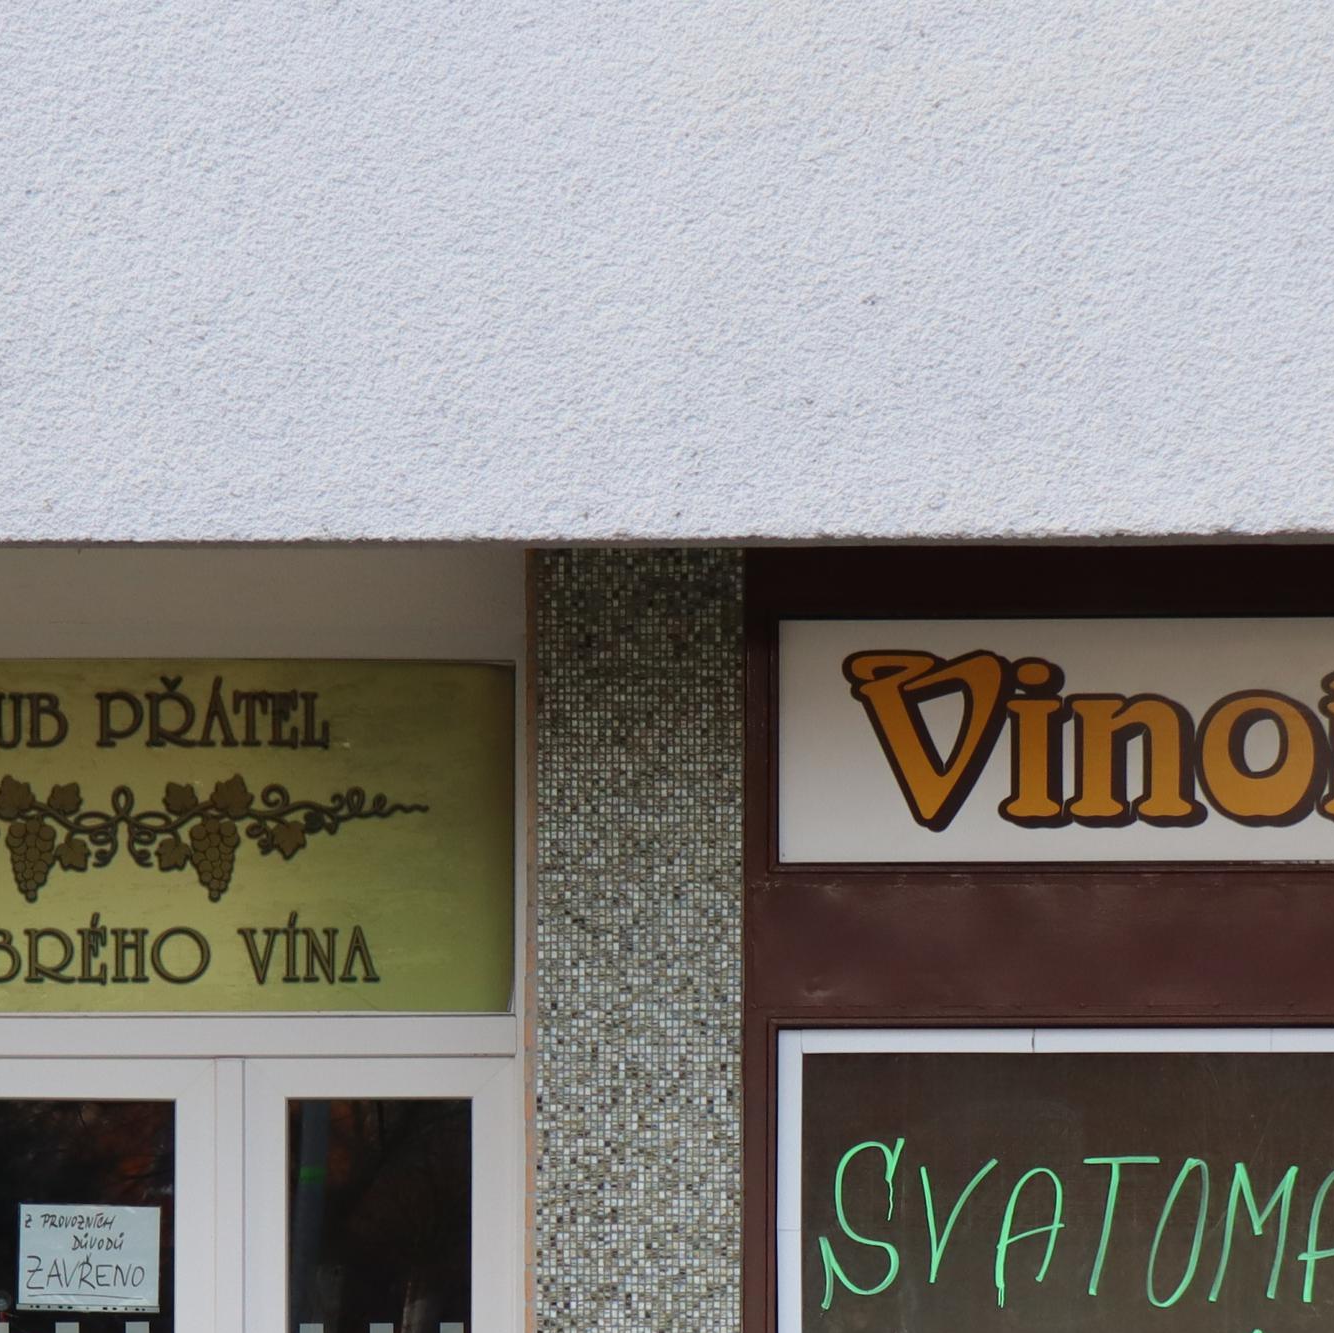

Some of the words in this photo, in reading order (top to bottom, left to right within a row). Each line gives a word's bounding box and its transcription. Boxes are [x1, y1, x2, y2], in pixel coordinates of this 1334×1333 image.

[95, 674, 331, 750] PŘÁTEL
[237, 911, 380, 985] VÍNA
[40, 1212, 117, 1230] PROVOZNÍCH
[25, 1252, 146, 1290] ZAVŘENO
